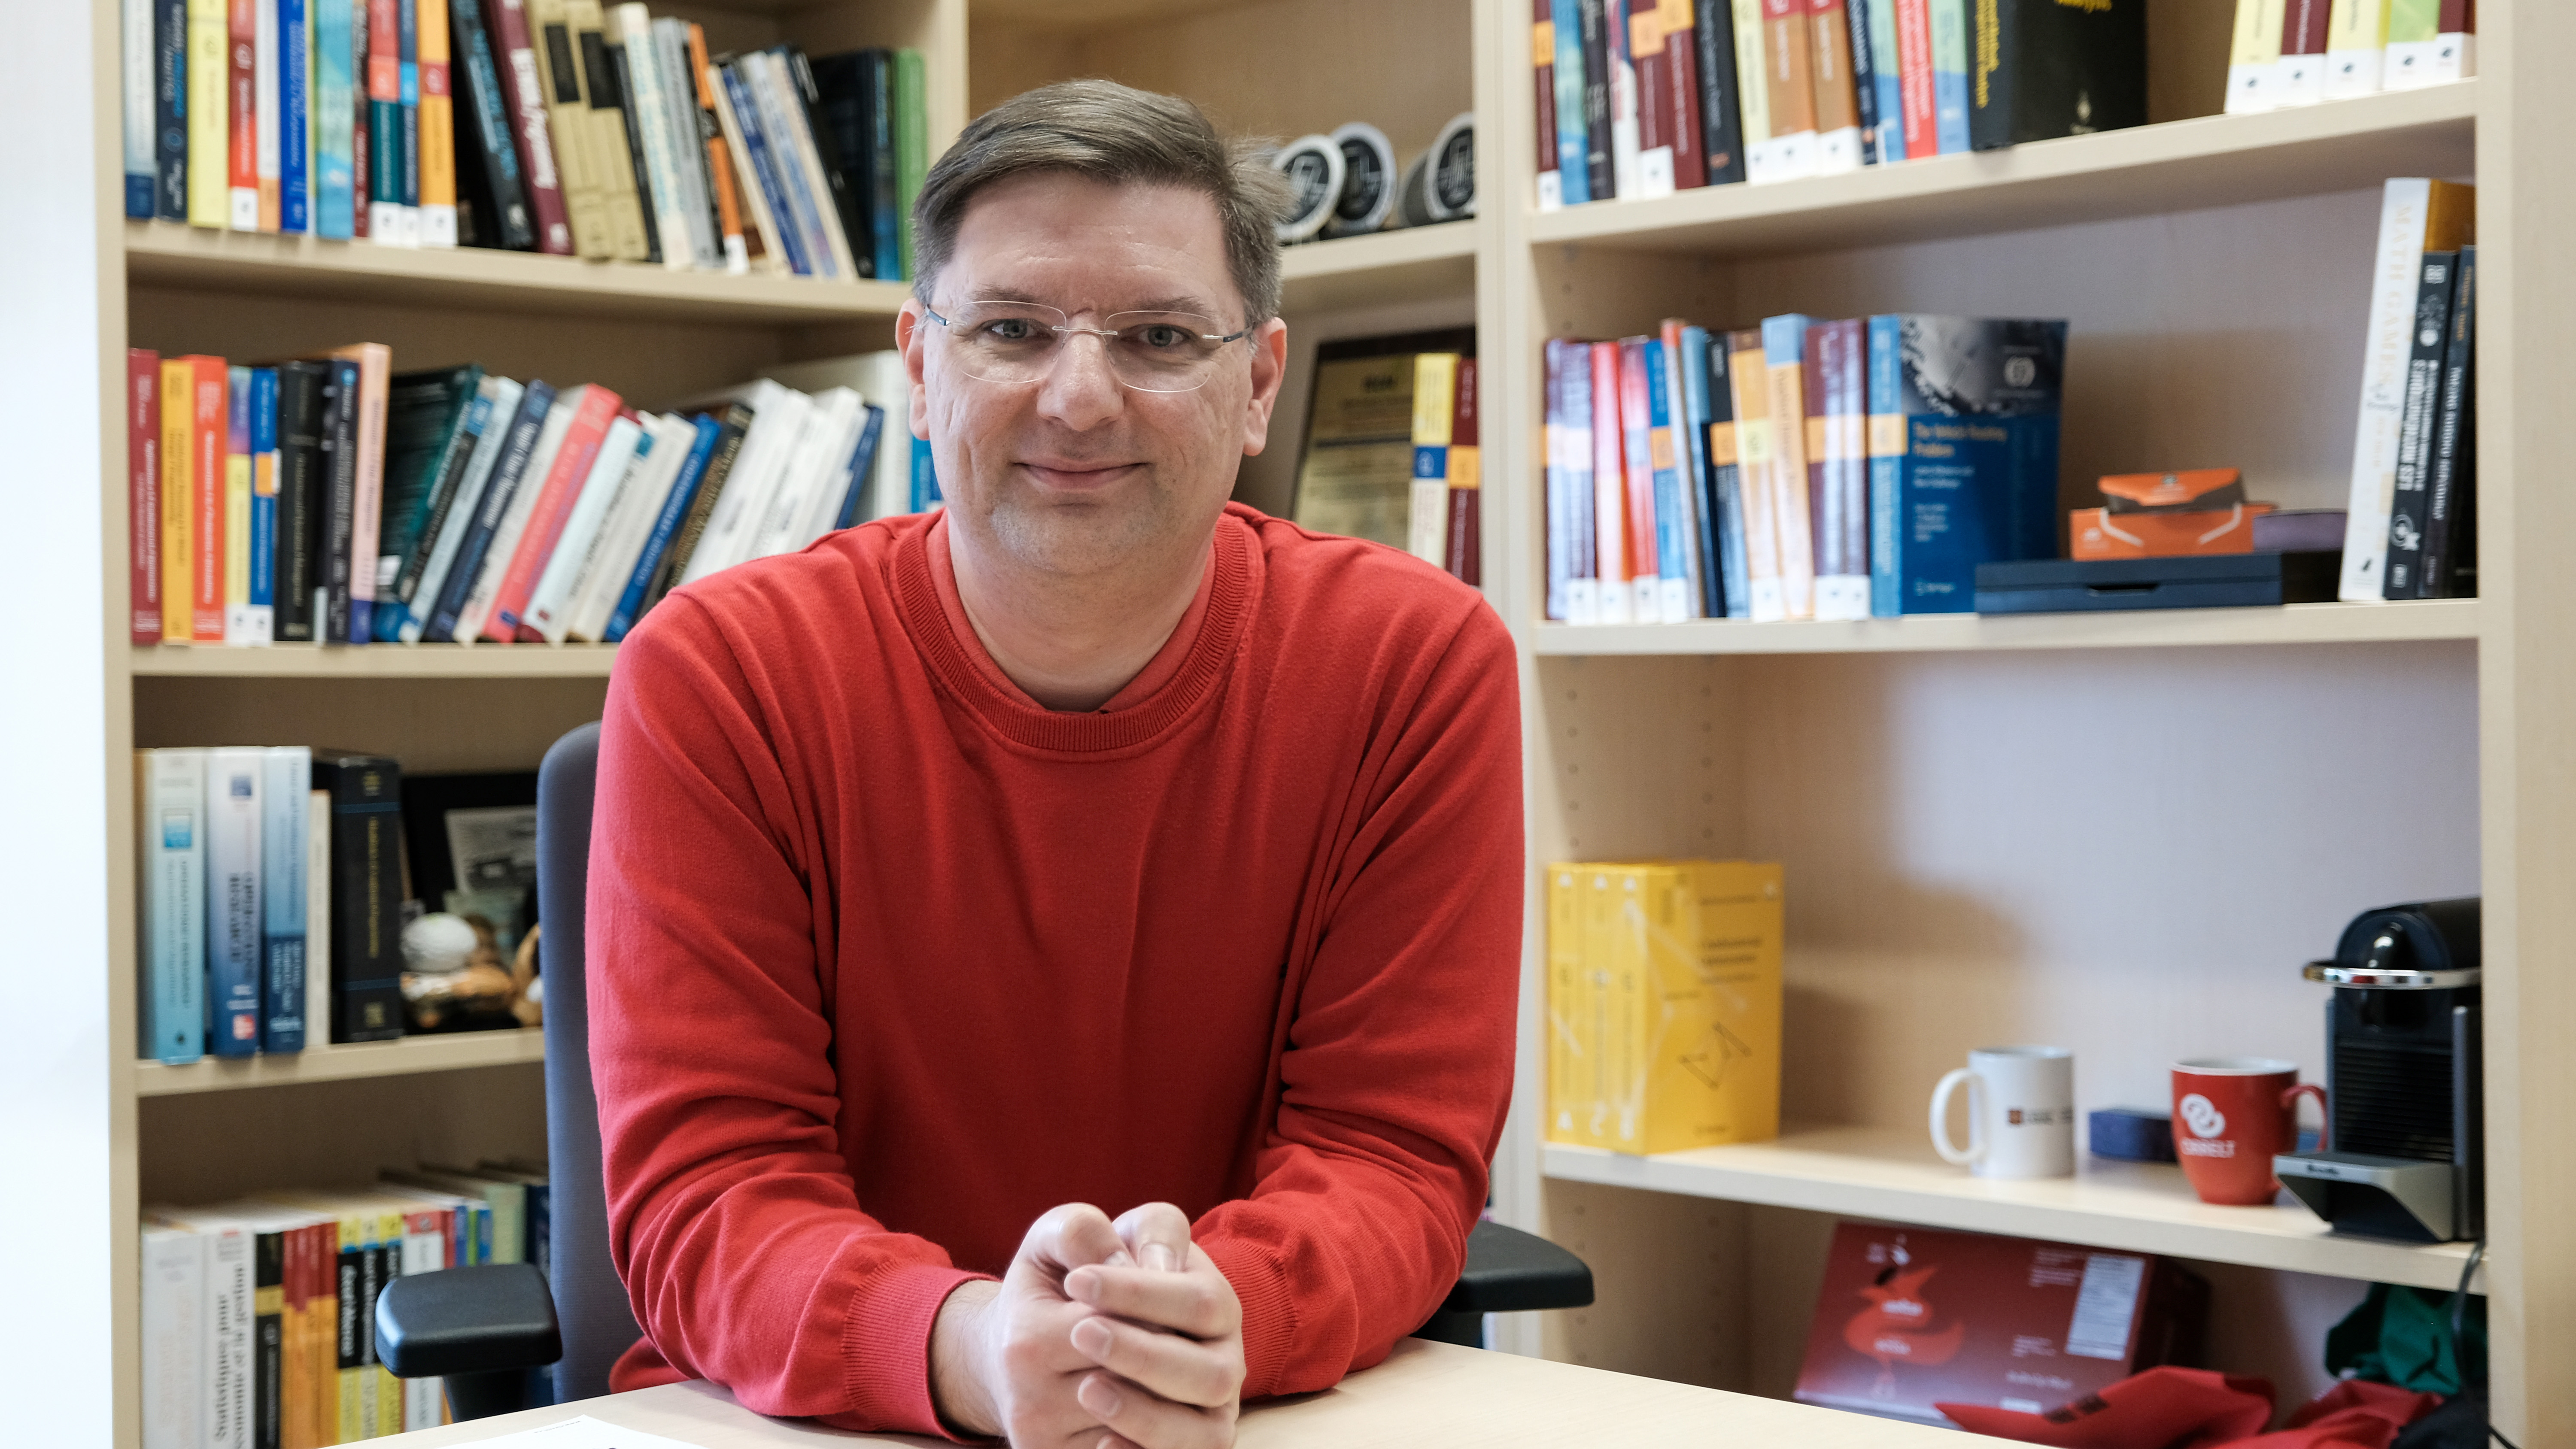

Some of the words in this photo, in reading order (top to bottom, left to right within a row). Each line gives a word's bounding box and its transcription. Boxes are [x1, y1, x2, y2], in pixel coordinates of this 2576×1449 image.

[2390, 203, 2413, 282] MATH
[2376, 291, 2402, 387] GAMES
[2446, 366, 2463, 409] TAKING
[2440, 412, 2457, 457] SUDOKU
[2433, 460, 2452, 521] SERIOUSLY
[229, 873, 241, 963] RESEARCH
[232, 1264, 248, 1326] gestion
[340, 1264, 356, 1302] Excel
[215, 1294, 229, 1337] pour
[212, 1339, 229, 1442] Statistiques
